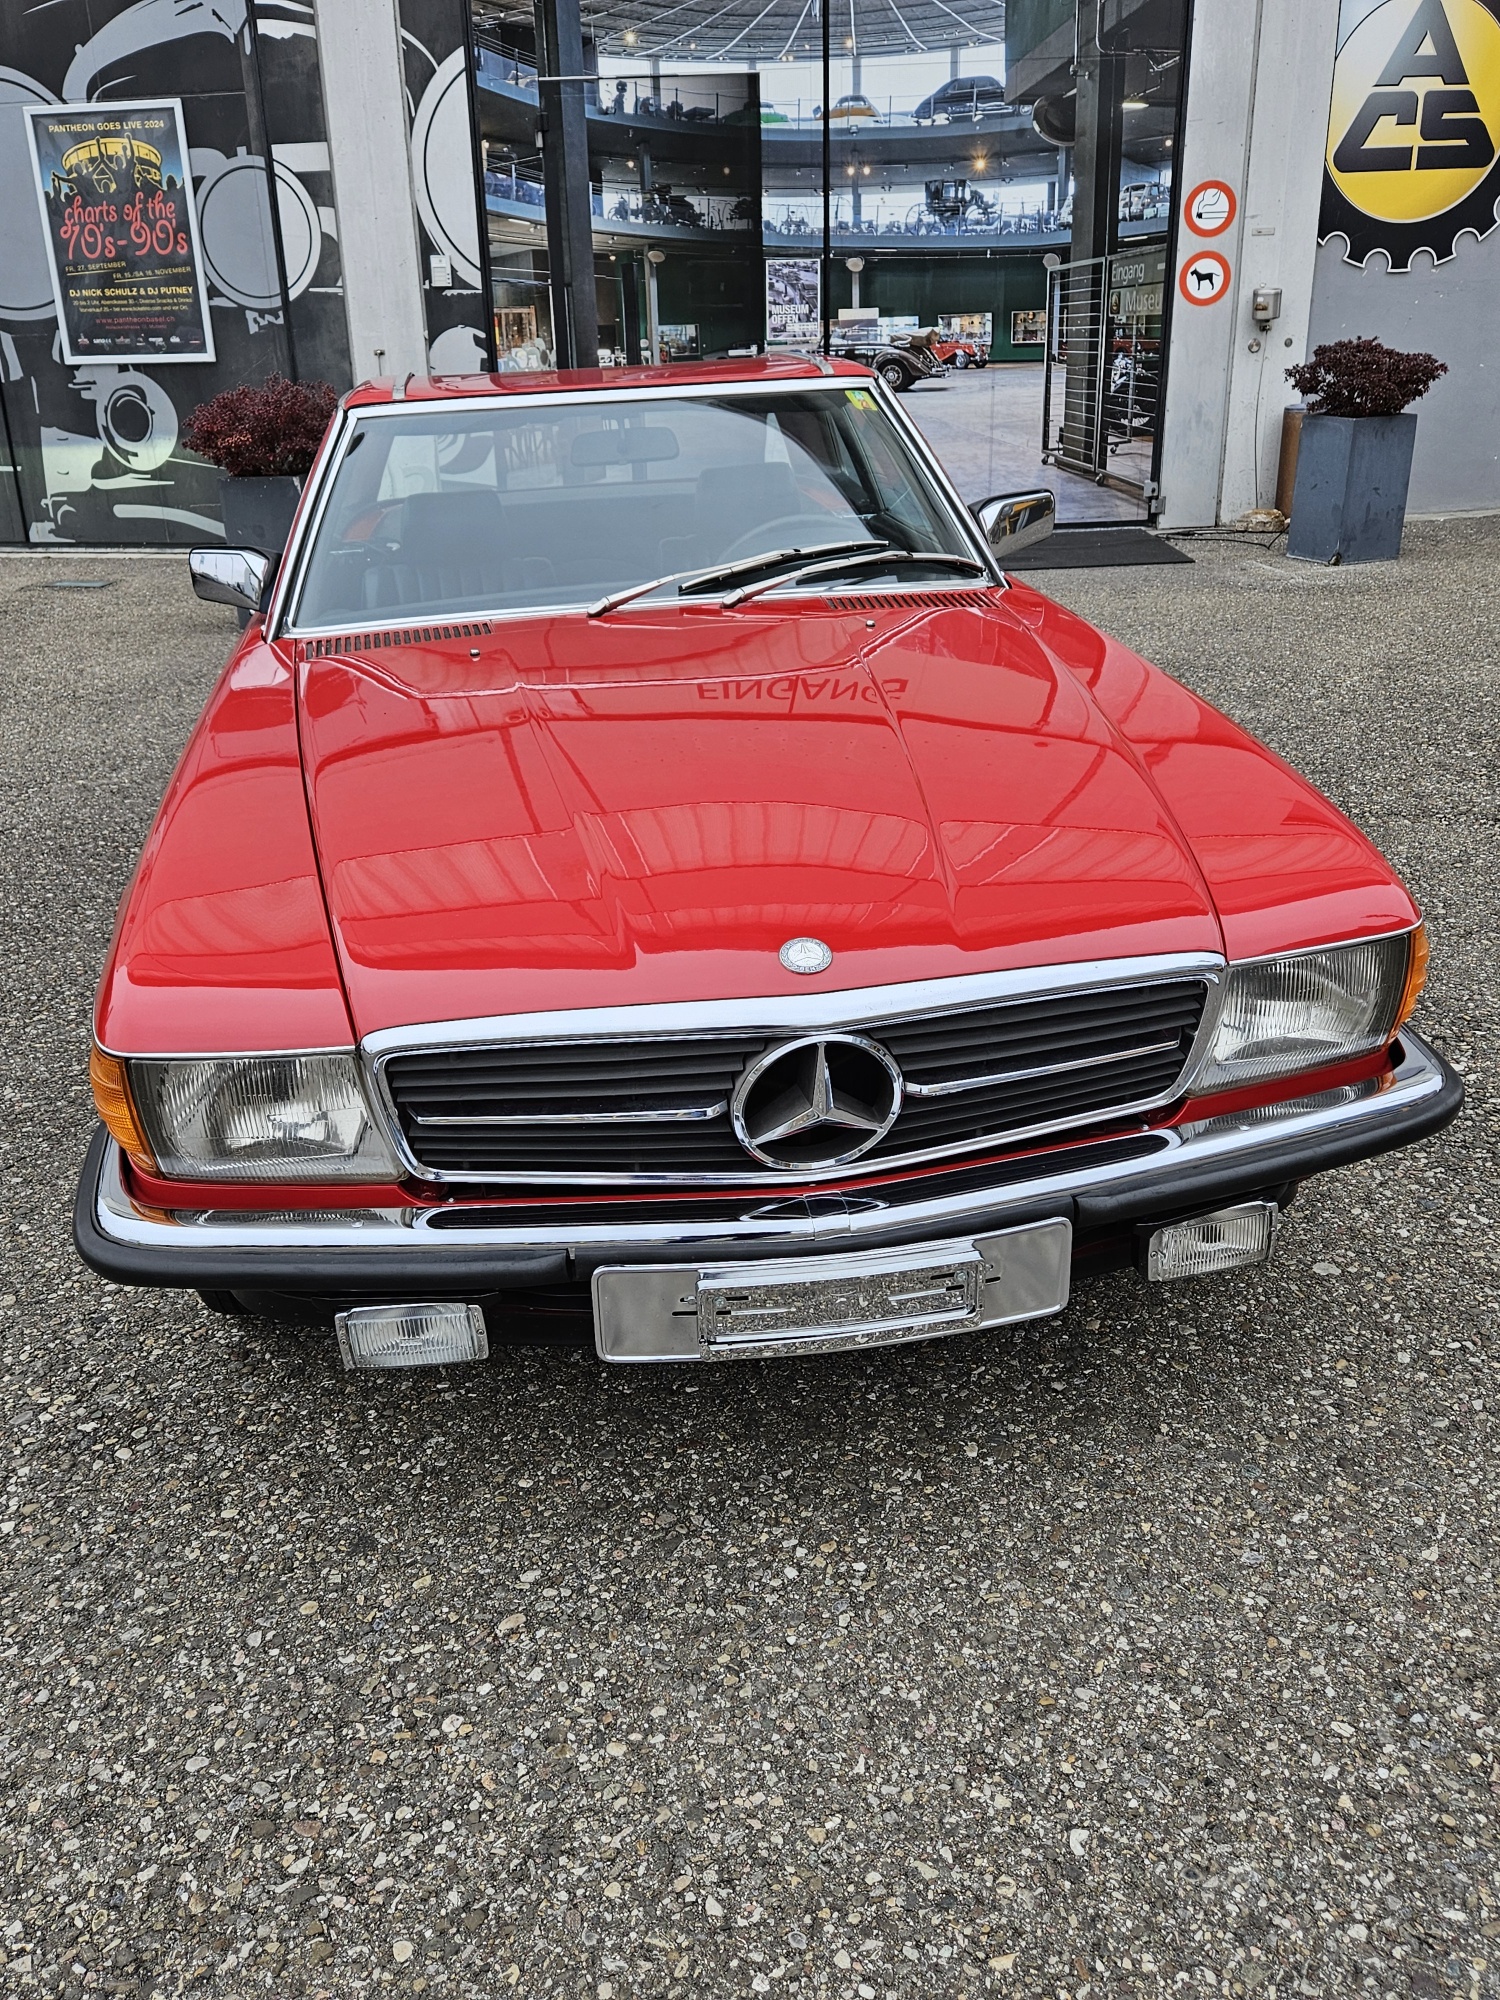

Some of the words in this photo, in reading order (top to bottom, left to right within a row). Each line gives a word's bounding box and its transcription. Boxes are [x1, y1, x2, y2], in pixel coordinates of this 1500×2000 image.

[48, 123, 95, 133] PANTHEON
[97, 121, 121, 131] GOES
[123, 120, 142, 130] LIVE
[144, 119, 165, 129] 2024
[63, 195, 118, 224] charts
[123, 191, 145, 230] of
[146, 190, 176, 219] the
[65, 265, 76, 273] FR.
[87, 260, 127, 271] SEPTEMBER
[155, 266, 192, 276] NOVEMBER
[1111, 262, 1145, 285] Eingang
[69, 289, 81, 298] DJ
[82, 288, 103, 298] NICK
[104, 287, 138, 297] SCHULZ
[139, 287, 146, 296] &
[147, 287, 159, 296] DJ
[160, 285, 193, 295] PUTNEY
[1125, 290, 1162, 312] Museu
[771, 304, 809, 315] MUSEUM
[771, 314, 799, 324] OFFEN
